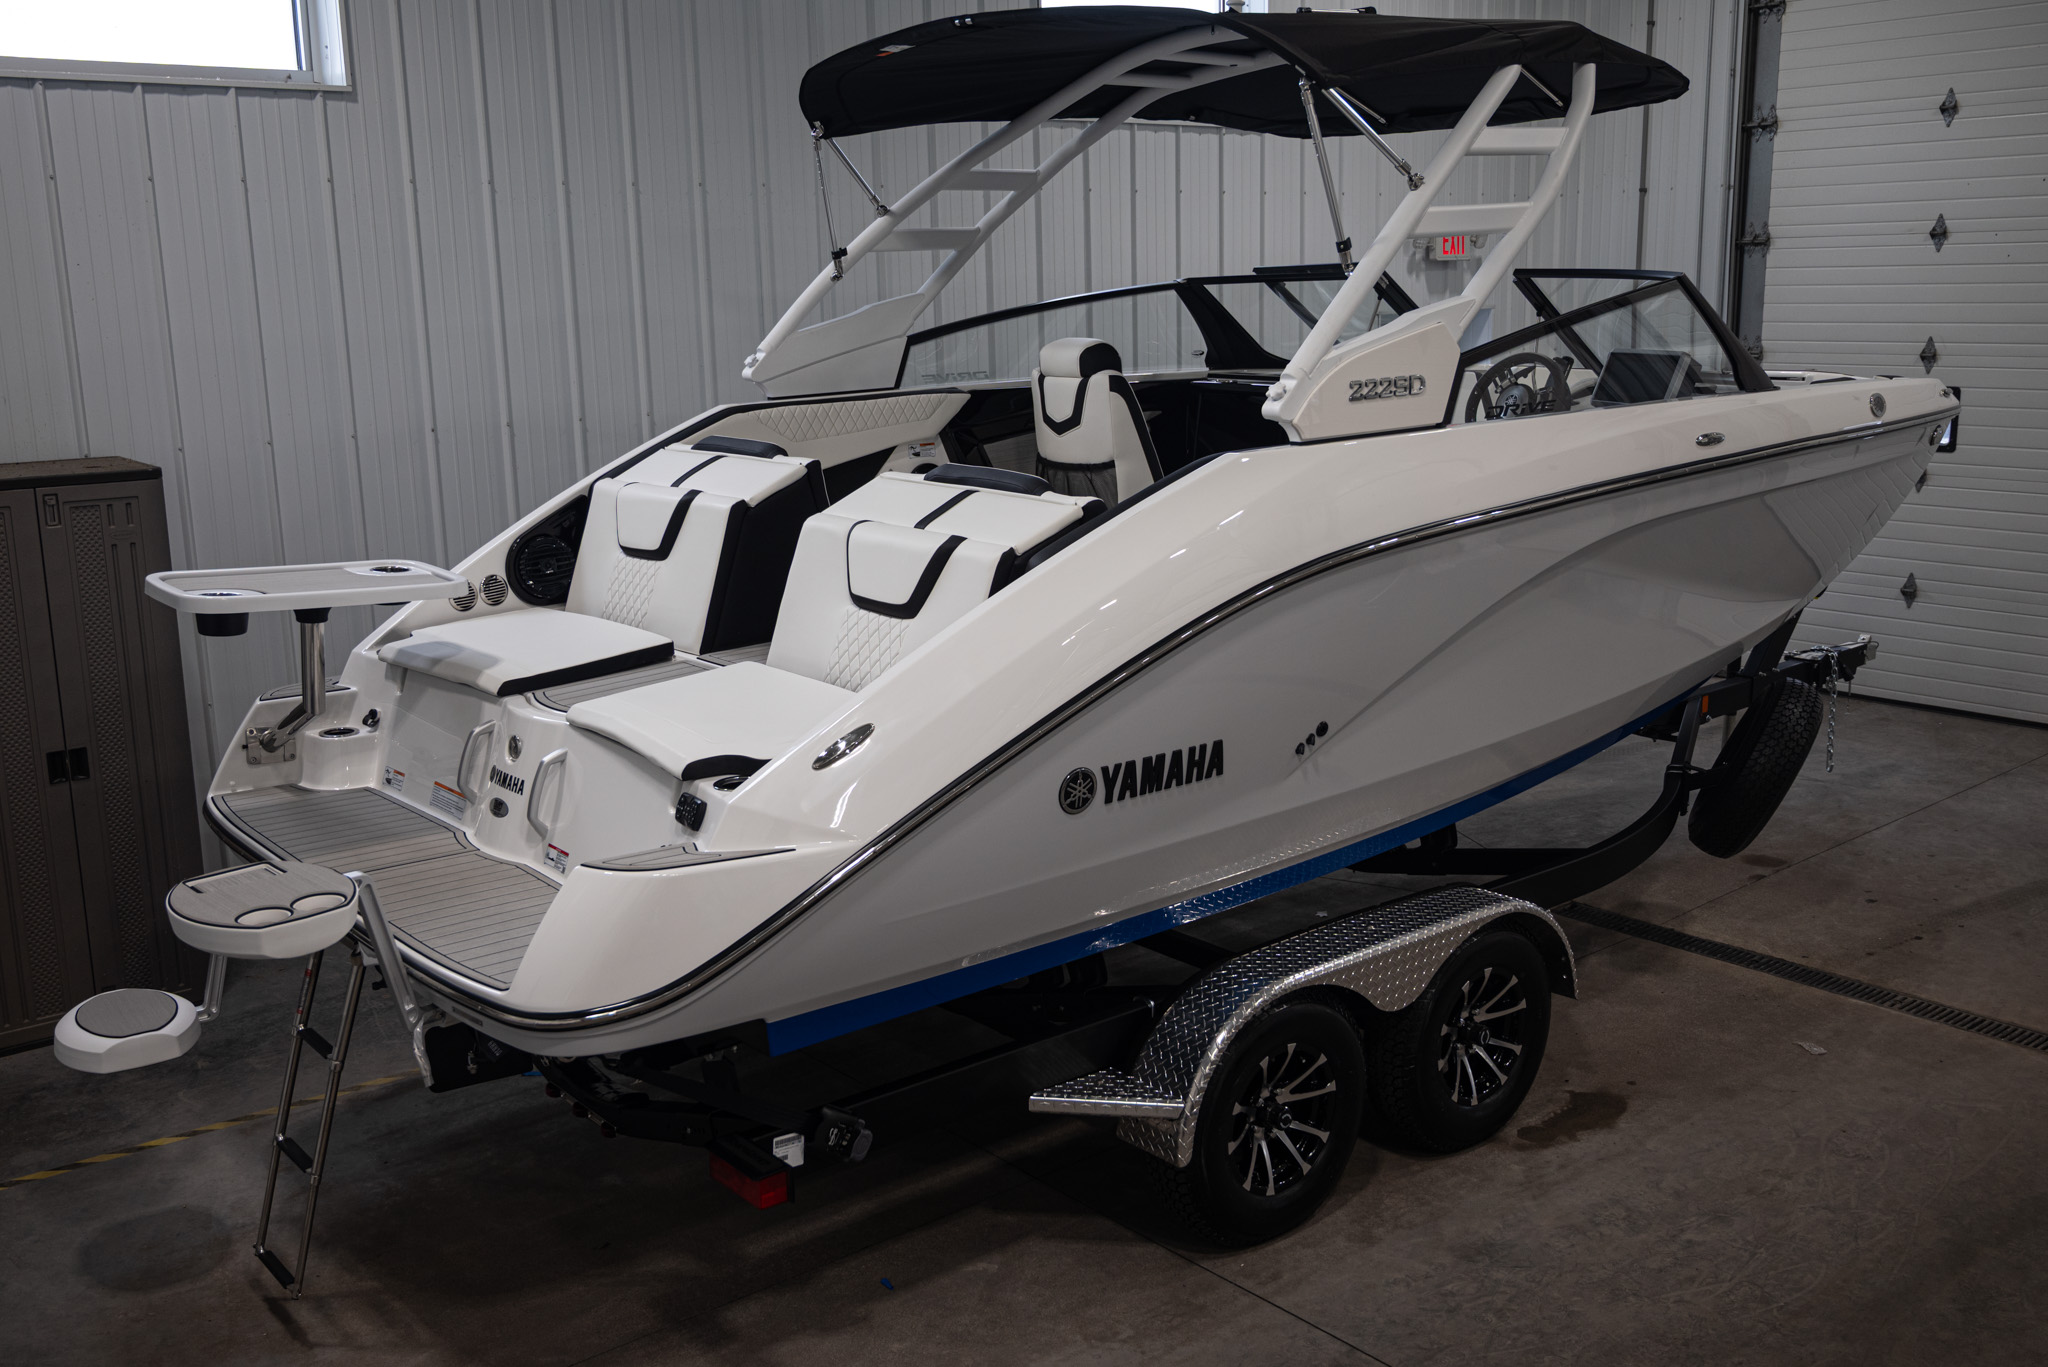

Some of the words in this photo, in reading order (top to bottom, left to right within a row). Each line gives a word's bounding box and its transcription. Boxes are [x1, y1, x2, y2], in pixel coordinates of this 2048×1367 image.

[1349, 375, 1426, 401] 222SD
[495, 768, 525, 795] YAMAHA
[1101, 739, 1223, 804] YAMAHA
